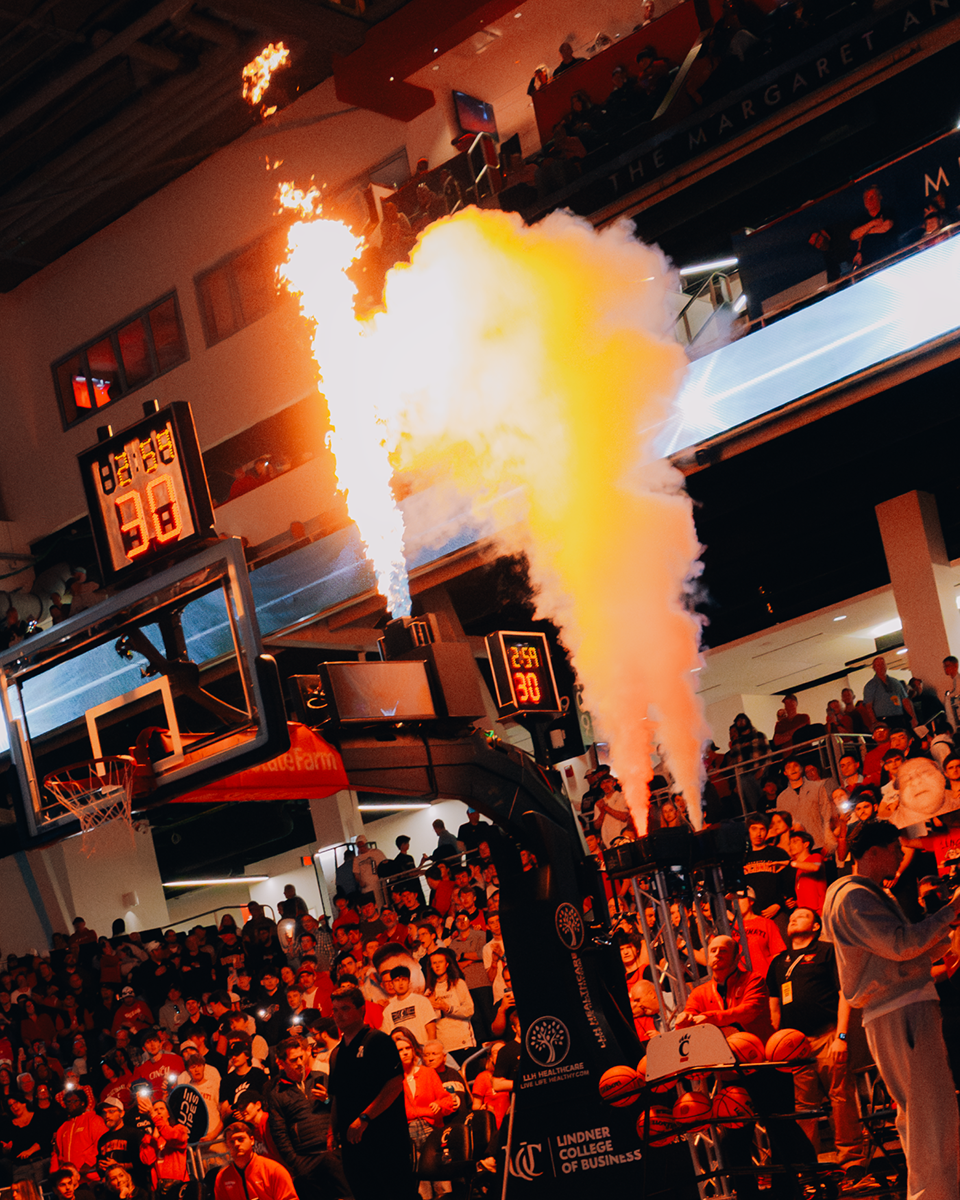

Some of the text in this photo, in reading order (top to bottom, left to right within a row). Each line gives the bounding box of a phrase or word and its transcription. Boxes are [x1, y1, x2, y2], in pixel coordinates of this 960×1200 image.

[607, 150, 666, 192] THE
[689, 30, 875, 149] MARGARET
[114, 473, 182, 558] 30
[514, 672, 541, 702] 30
[519, 1080, 534, 1090] LIVE
[534, 1077, 548, 1087] LIFE
[522, 1061, 585, 1082] LLH HEALTHCARE
[177, 1087, 193, 1125] UDE
[556, 1126, 611, 1147] LINDNER
[558, 1140, 614, 1160] COLLEGE
[561, 1149, 643, 1174] OF BUSINESS
